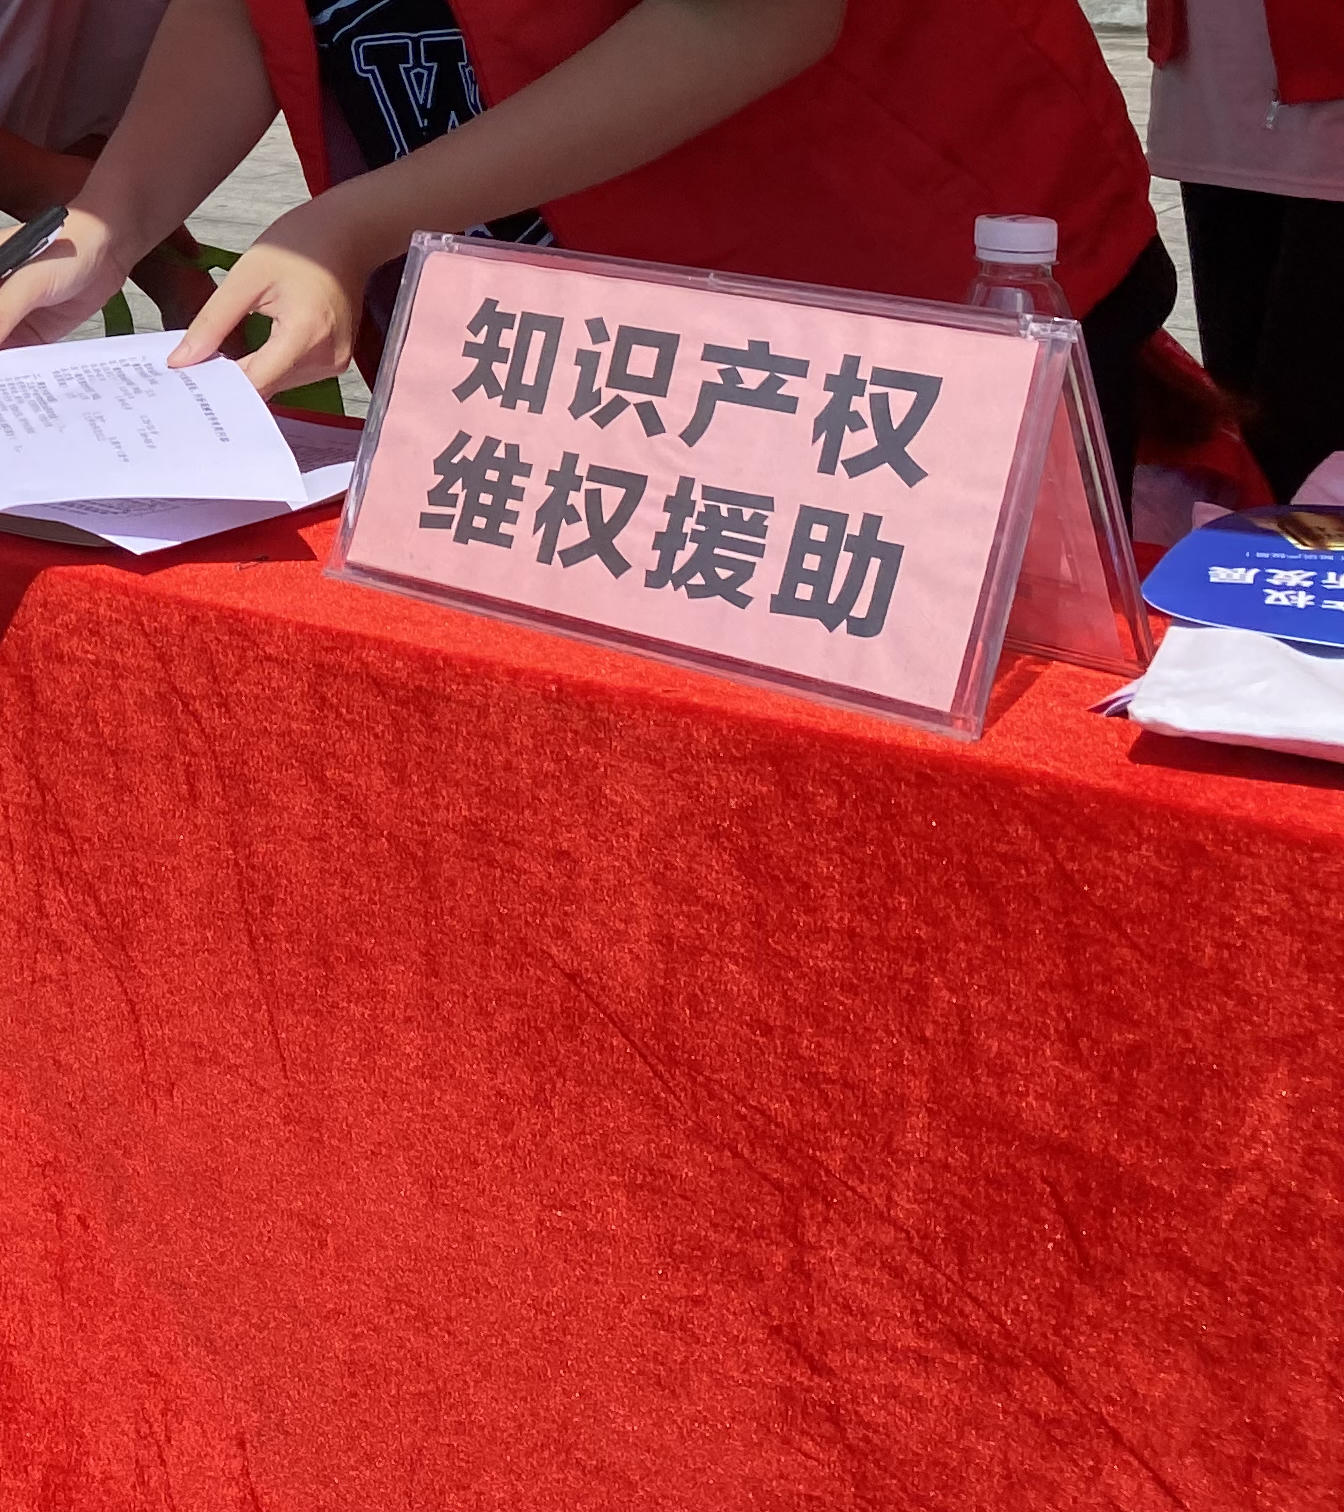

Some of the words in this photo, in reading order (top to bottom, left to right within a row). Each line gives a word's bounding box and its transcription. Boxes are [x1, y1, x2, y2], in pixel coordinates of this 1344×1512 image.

[451, 296, 944, 488] 知识产权
[418, 430, 906, 638] 维权援助
